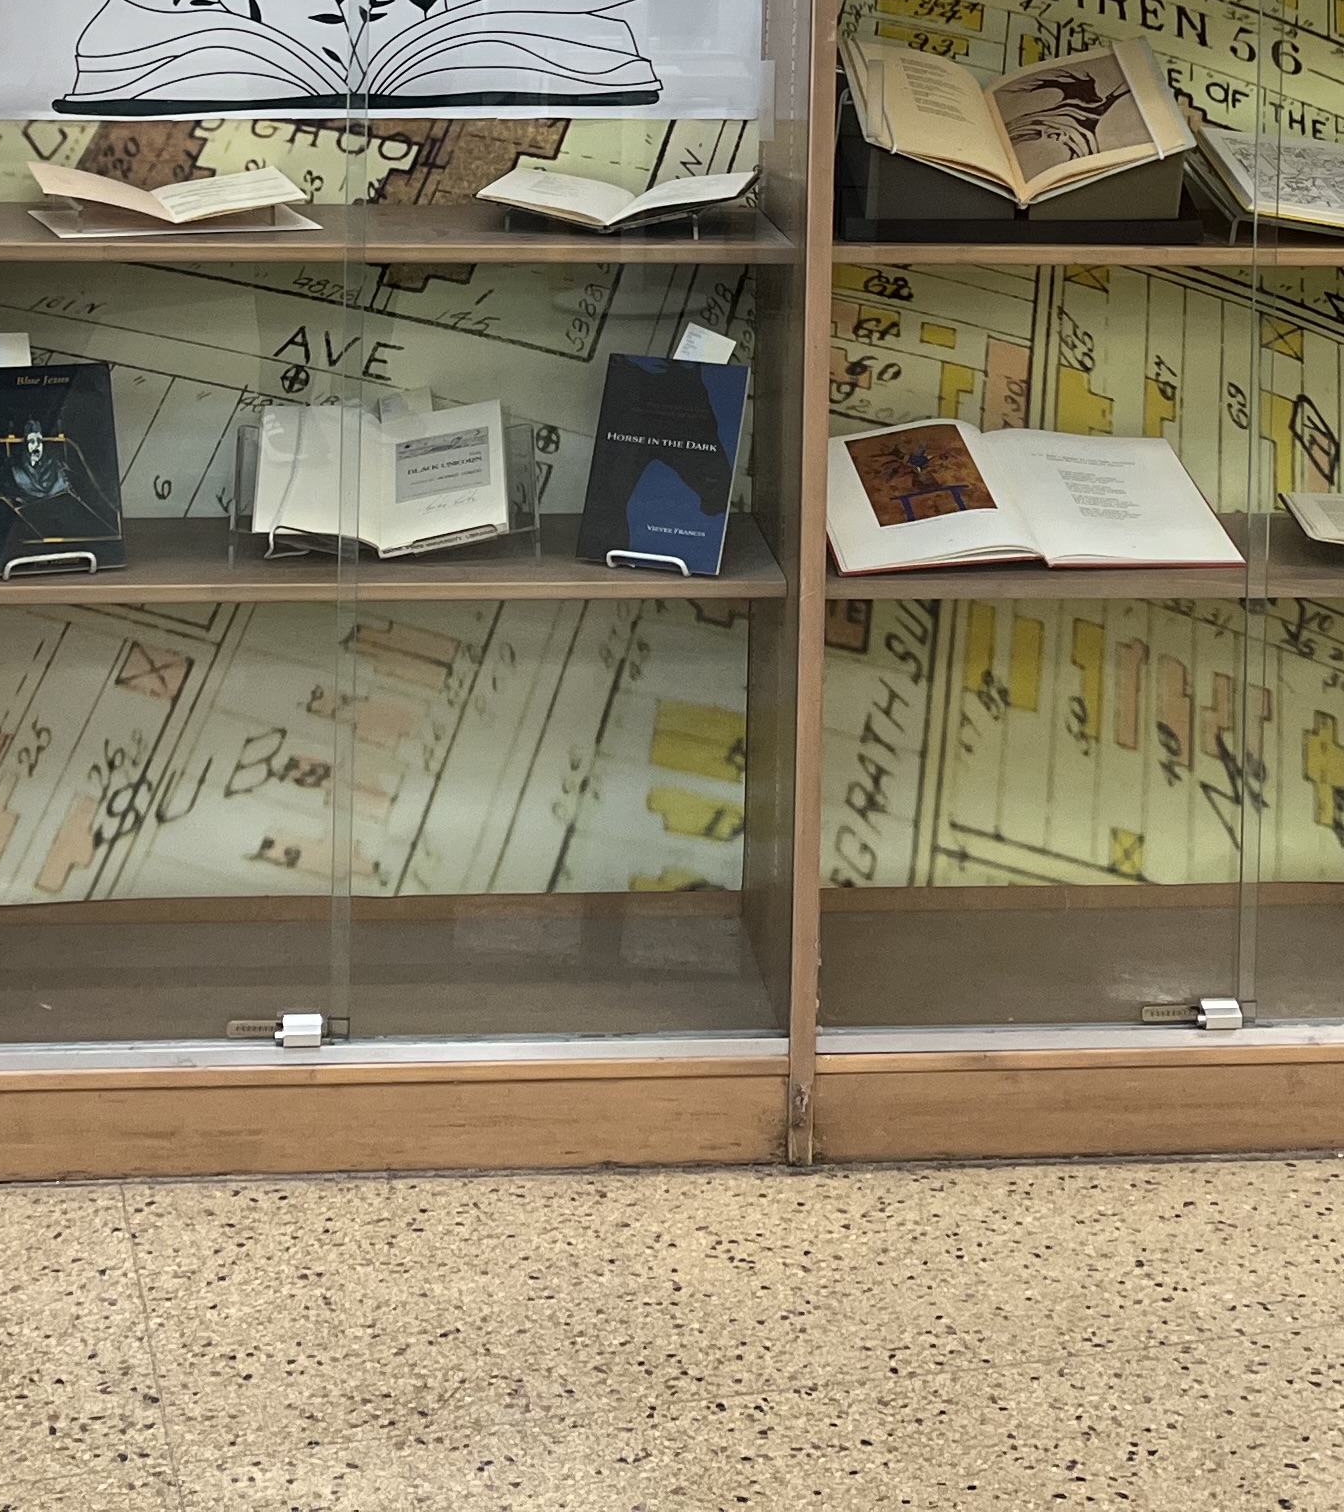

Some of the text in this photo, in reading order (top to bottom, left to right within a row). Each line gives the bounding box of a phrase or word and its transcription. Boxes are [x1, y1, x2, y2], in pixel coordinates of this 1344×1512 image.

[1229, 25, 1304, 76] 56
[274, 324, 405, 382] AVE
[16, 375, 70, 386] Blue Jesus
[607, 432, 645, 444] HORSE
[662, 438, 684, 449] THE
[685, 440, 717, 453] DARK
